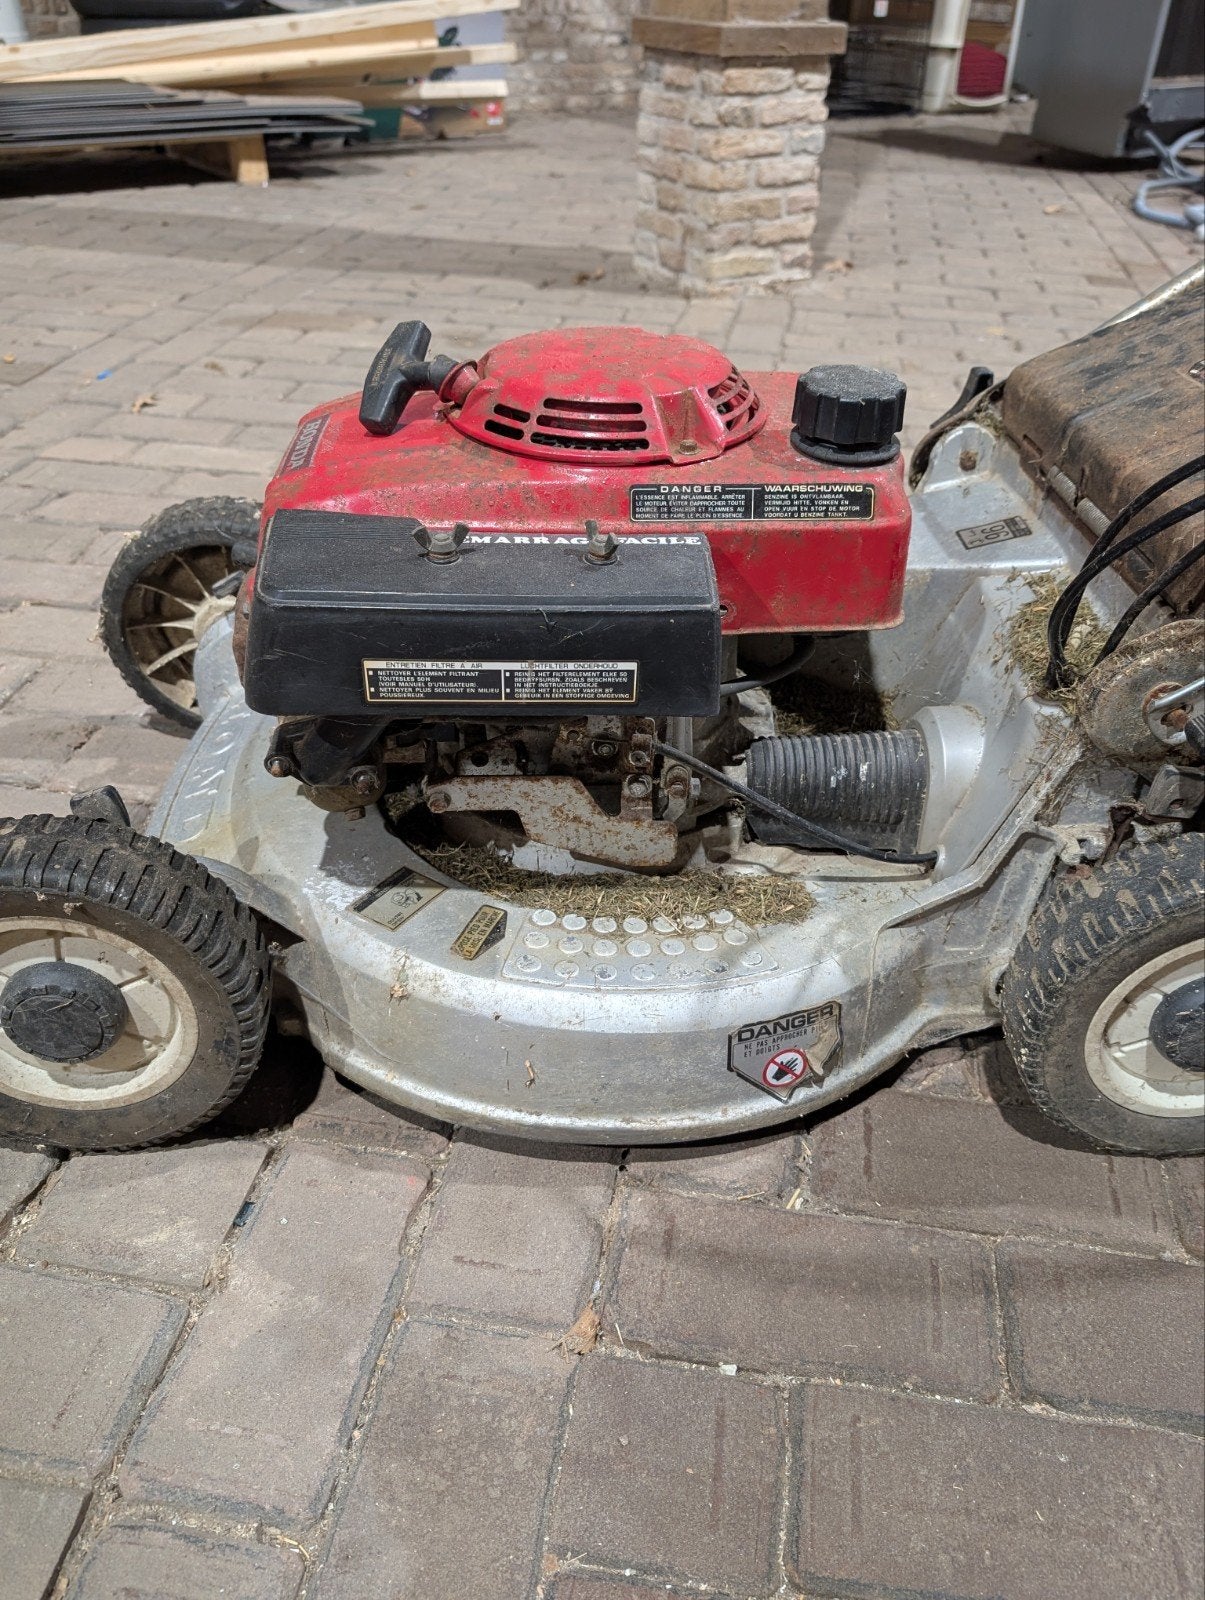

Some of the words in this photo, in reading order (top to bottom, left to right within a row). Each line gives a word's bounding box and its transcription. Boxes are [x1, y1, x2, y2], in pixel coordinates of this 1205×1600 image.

[461, 534, 589, 545] EMARRAG
[738, 1004, 834, 1042] DANGER
[757, 1039, 768, 1047] PAS
[773, 1029, 807, 1043] APPROCHER
